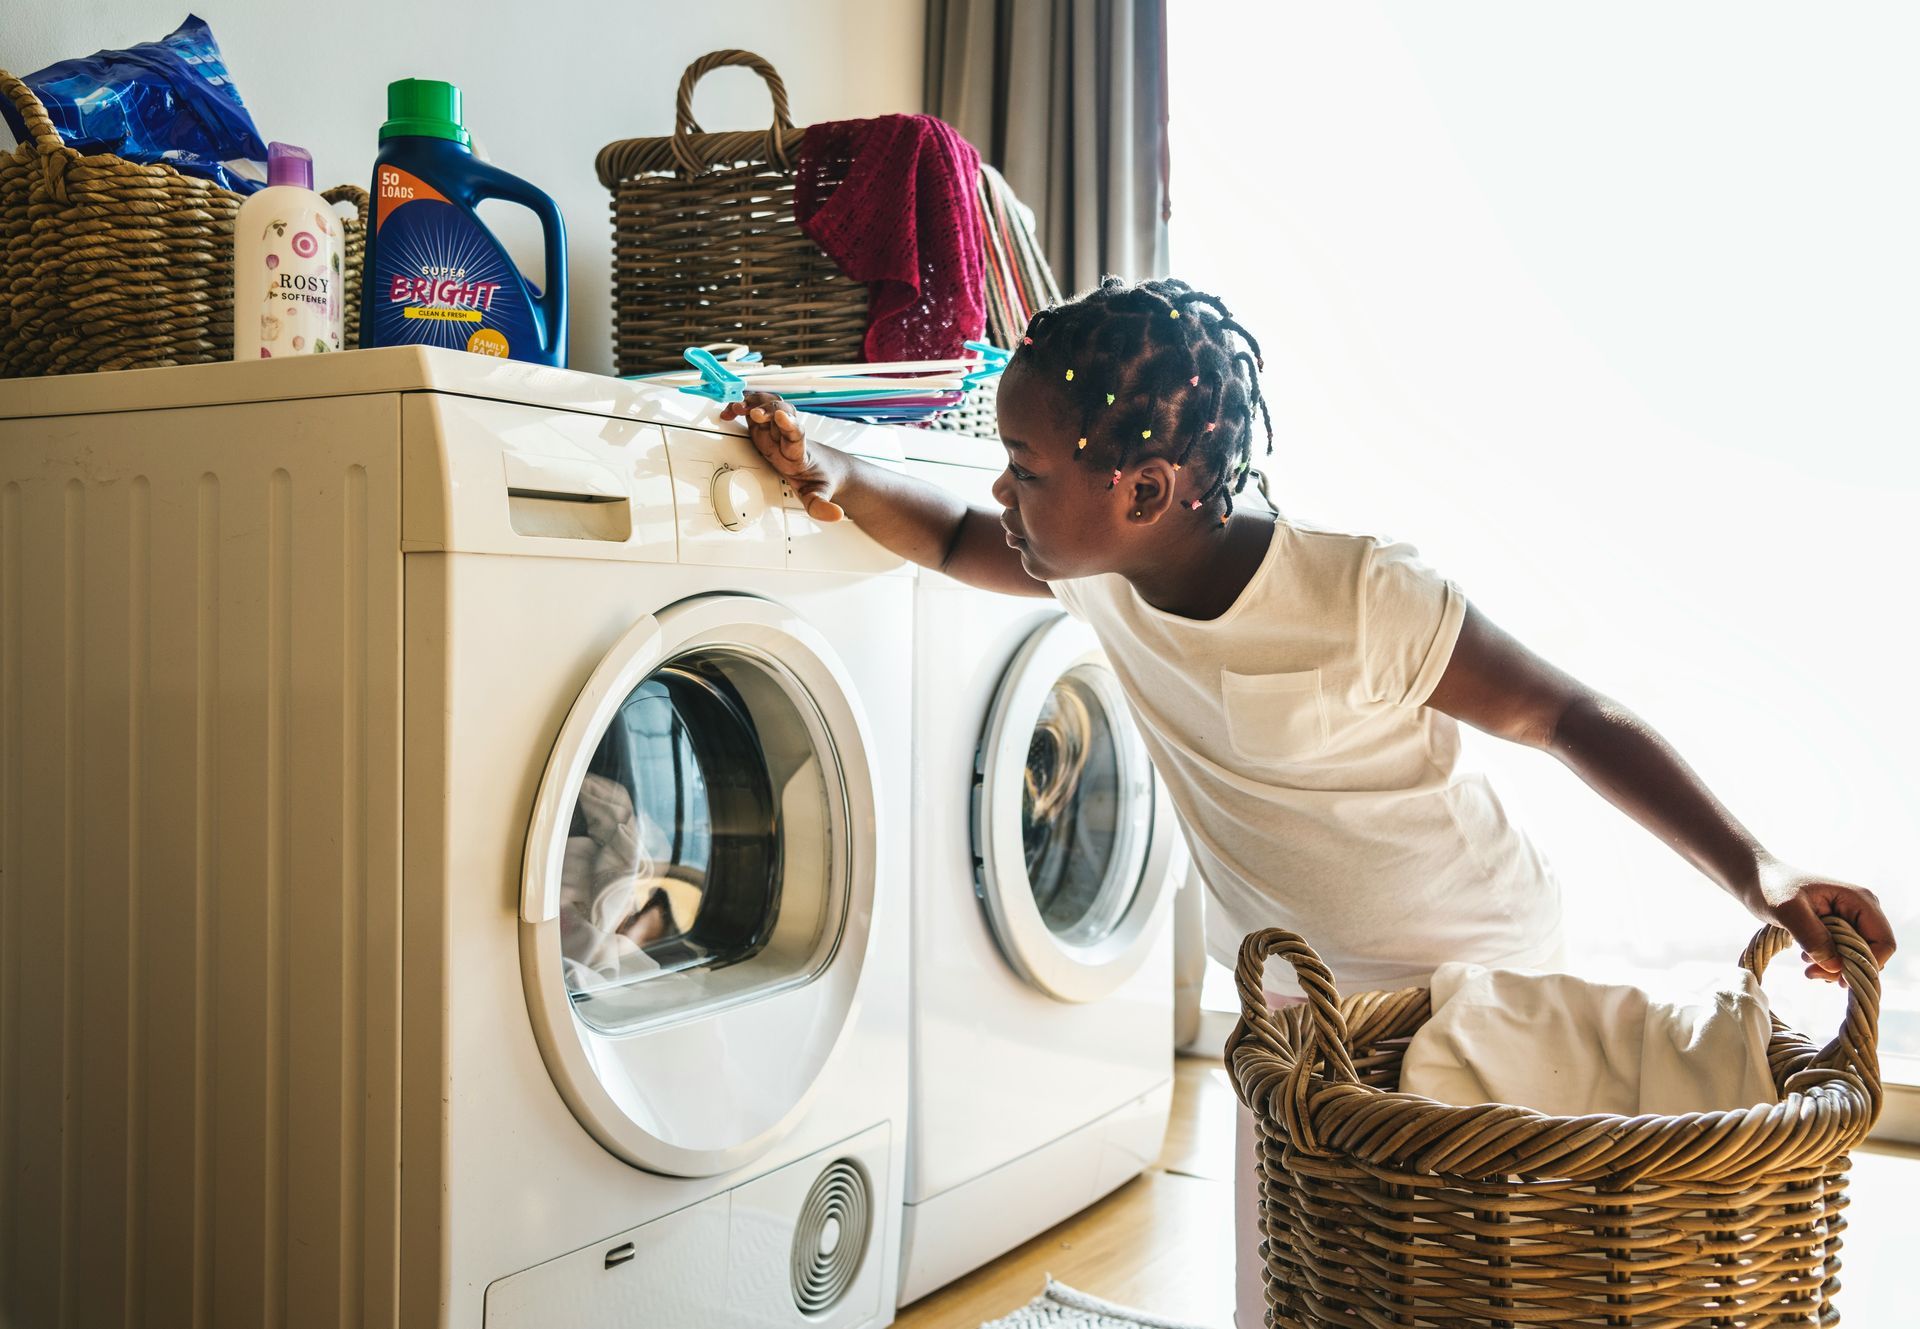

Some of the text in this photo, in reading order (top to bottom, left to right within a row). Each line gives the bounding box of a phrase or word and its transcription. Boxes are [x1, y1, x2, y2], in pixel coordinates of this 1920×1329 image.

[382, 172, 400, 186] 50
[382, 185, 414, 199] LOADS
[422, 265, 466, 278] SUPER
[279, 273, 329, 294] ROSY
[281, 292, 328, 305] SOFTENER
[389, 274, 501, 311] BRIGHT
[447, 311, 468, 319] FRESH
[472, 345, 501, 357] PACK
[473, 337, 506, 352] FAMILY
